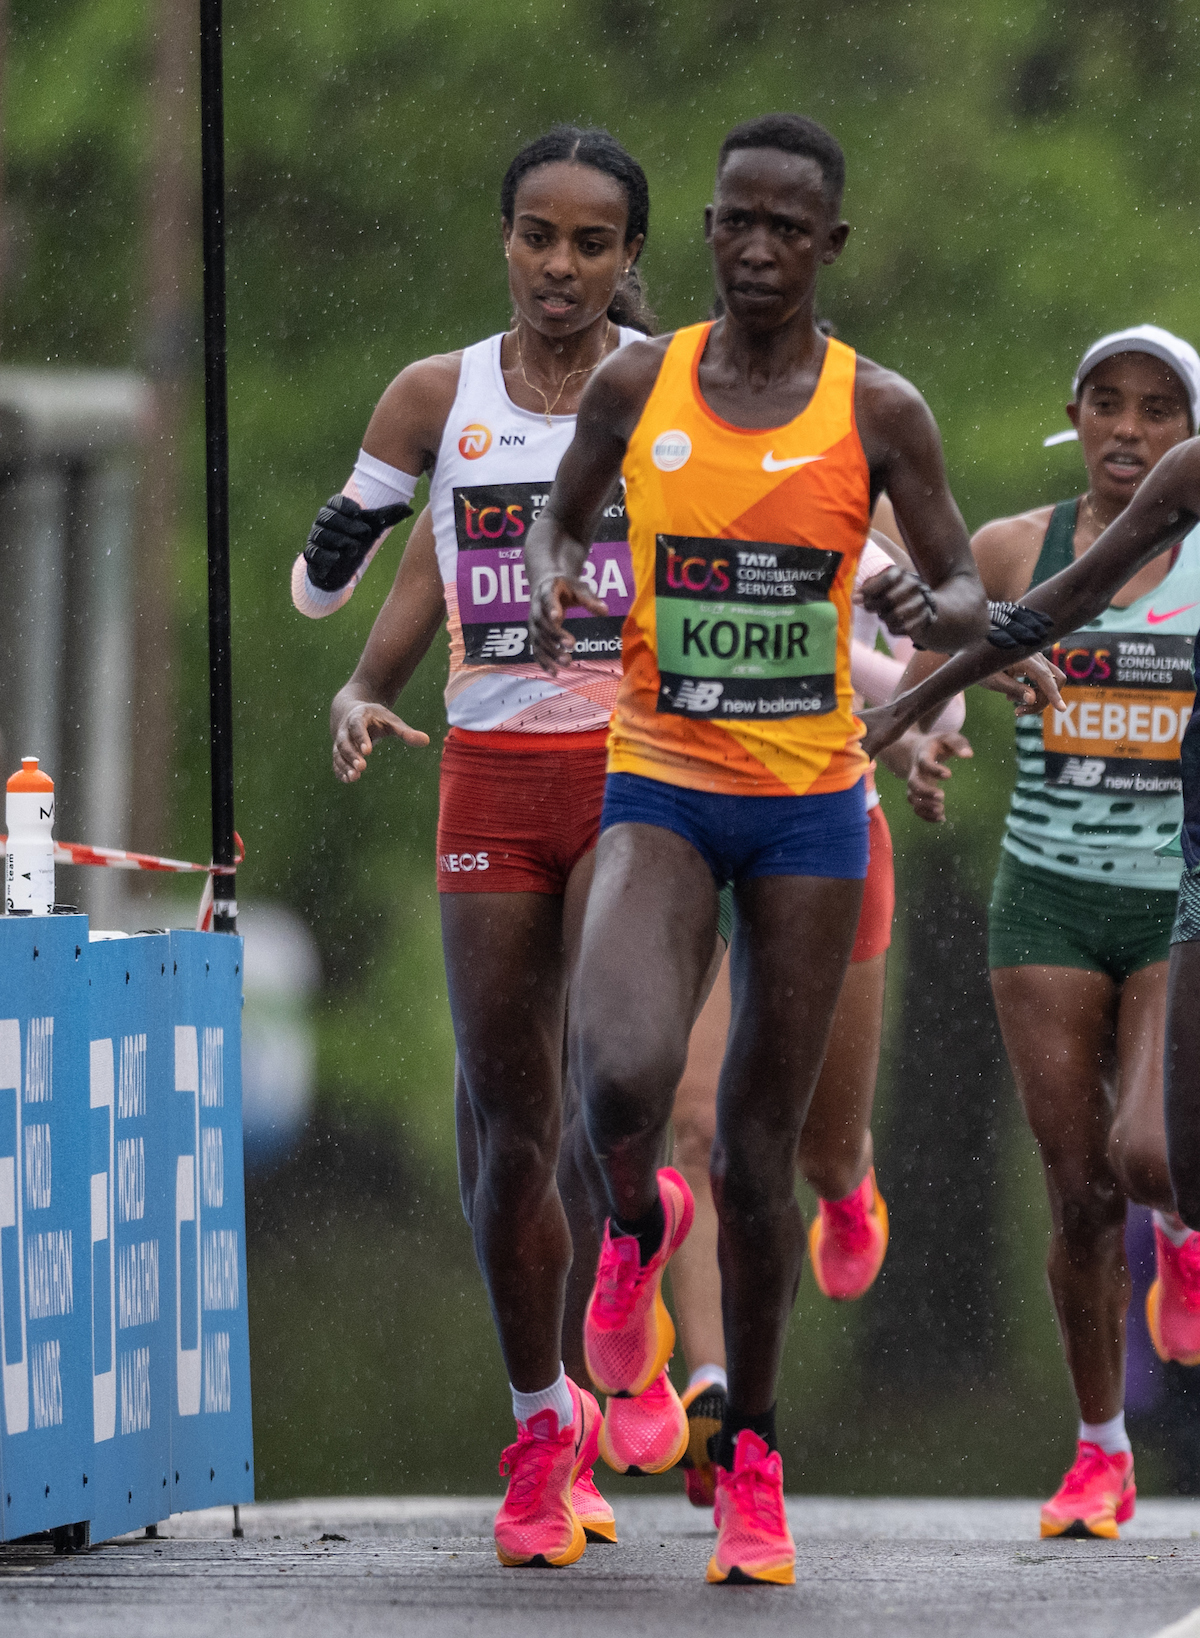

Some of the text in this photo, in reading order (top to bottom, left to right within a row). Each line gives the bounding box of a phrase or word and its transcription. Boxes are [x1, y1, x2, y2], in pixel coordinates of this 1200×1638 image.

[499, 435, 526, 446] NN
[465, 501, 525, 540] tcs
[666, 548, 730, 592] tcs
[737, 552, 778, 567] TATA
[737, 568, 825, 582] CONSULTANCY
[737, 582, 797, 597] SERVICES
[565, 638, 624, 653] alance
[682, 618, 810, 660] KORIR
[1117, 641, 1156, 656] TATA
[1116, 669, 1173, 684] SERVICES
[723, 699, 756, 714] new
[758, 697, 822, 714] balance
[1104, 776, 1134, 790] new
[25, 1016, 54, 1104] ABBOTT
[118, 1033, 147, 1120] ABBOTT
[25, 1123, 51, 1211] WORLD
[117, 1136, 146, 1224] WORLD
[28, 1229, 74, 1320] MARATHON
[119, 1238, 160, 1330] MARATHON
[32, 1338, 63, 1430] MAJORS
[120, 1345, 151, 1436] MAJORS
